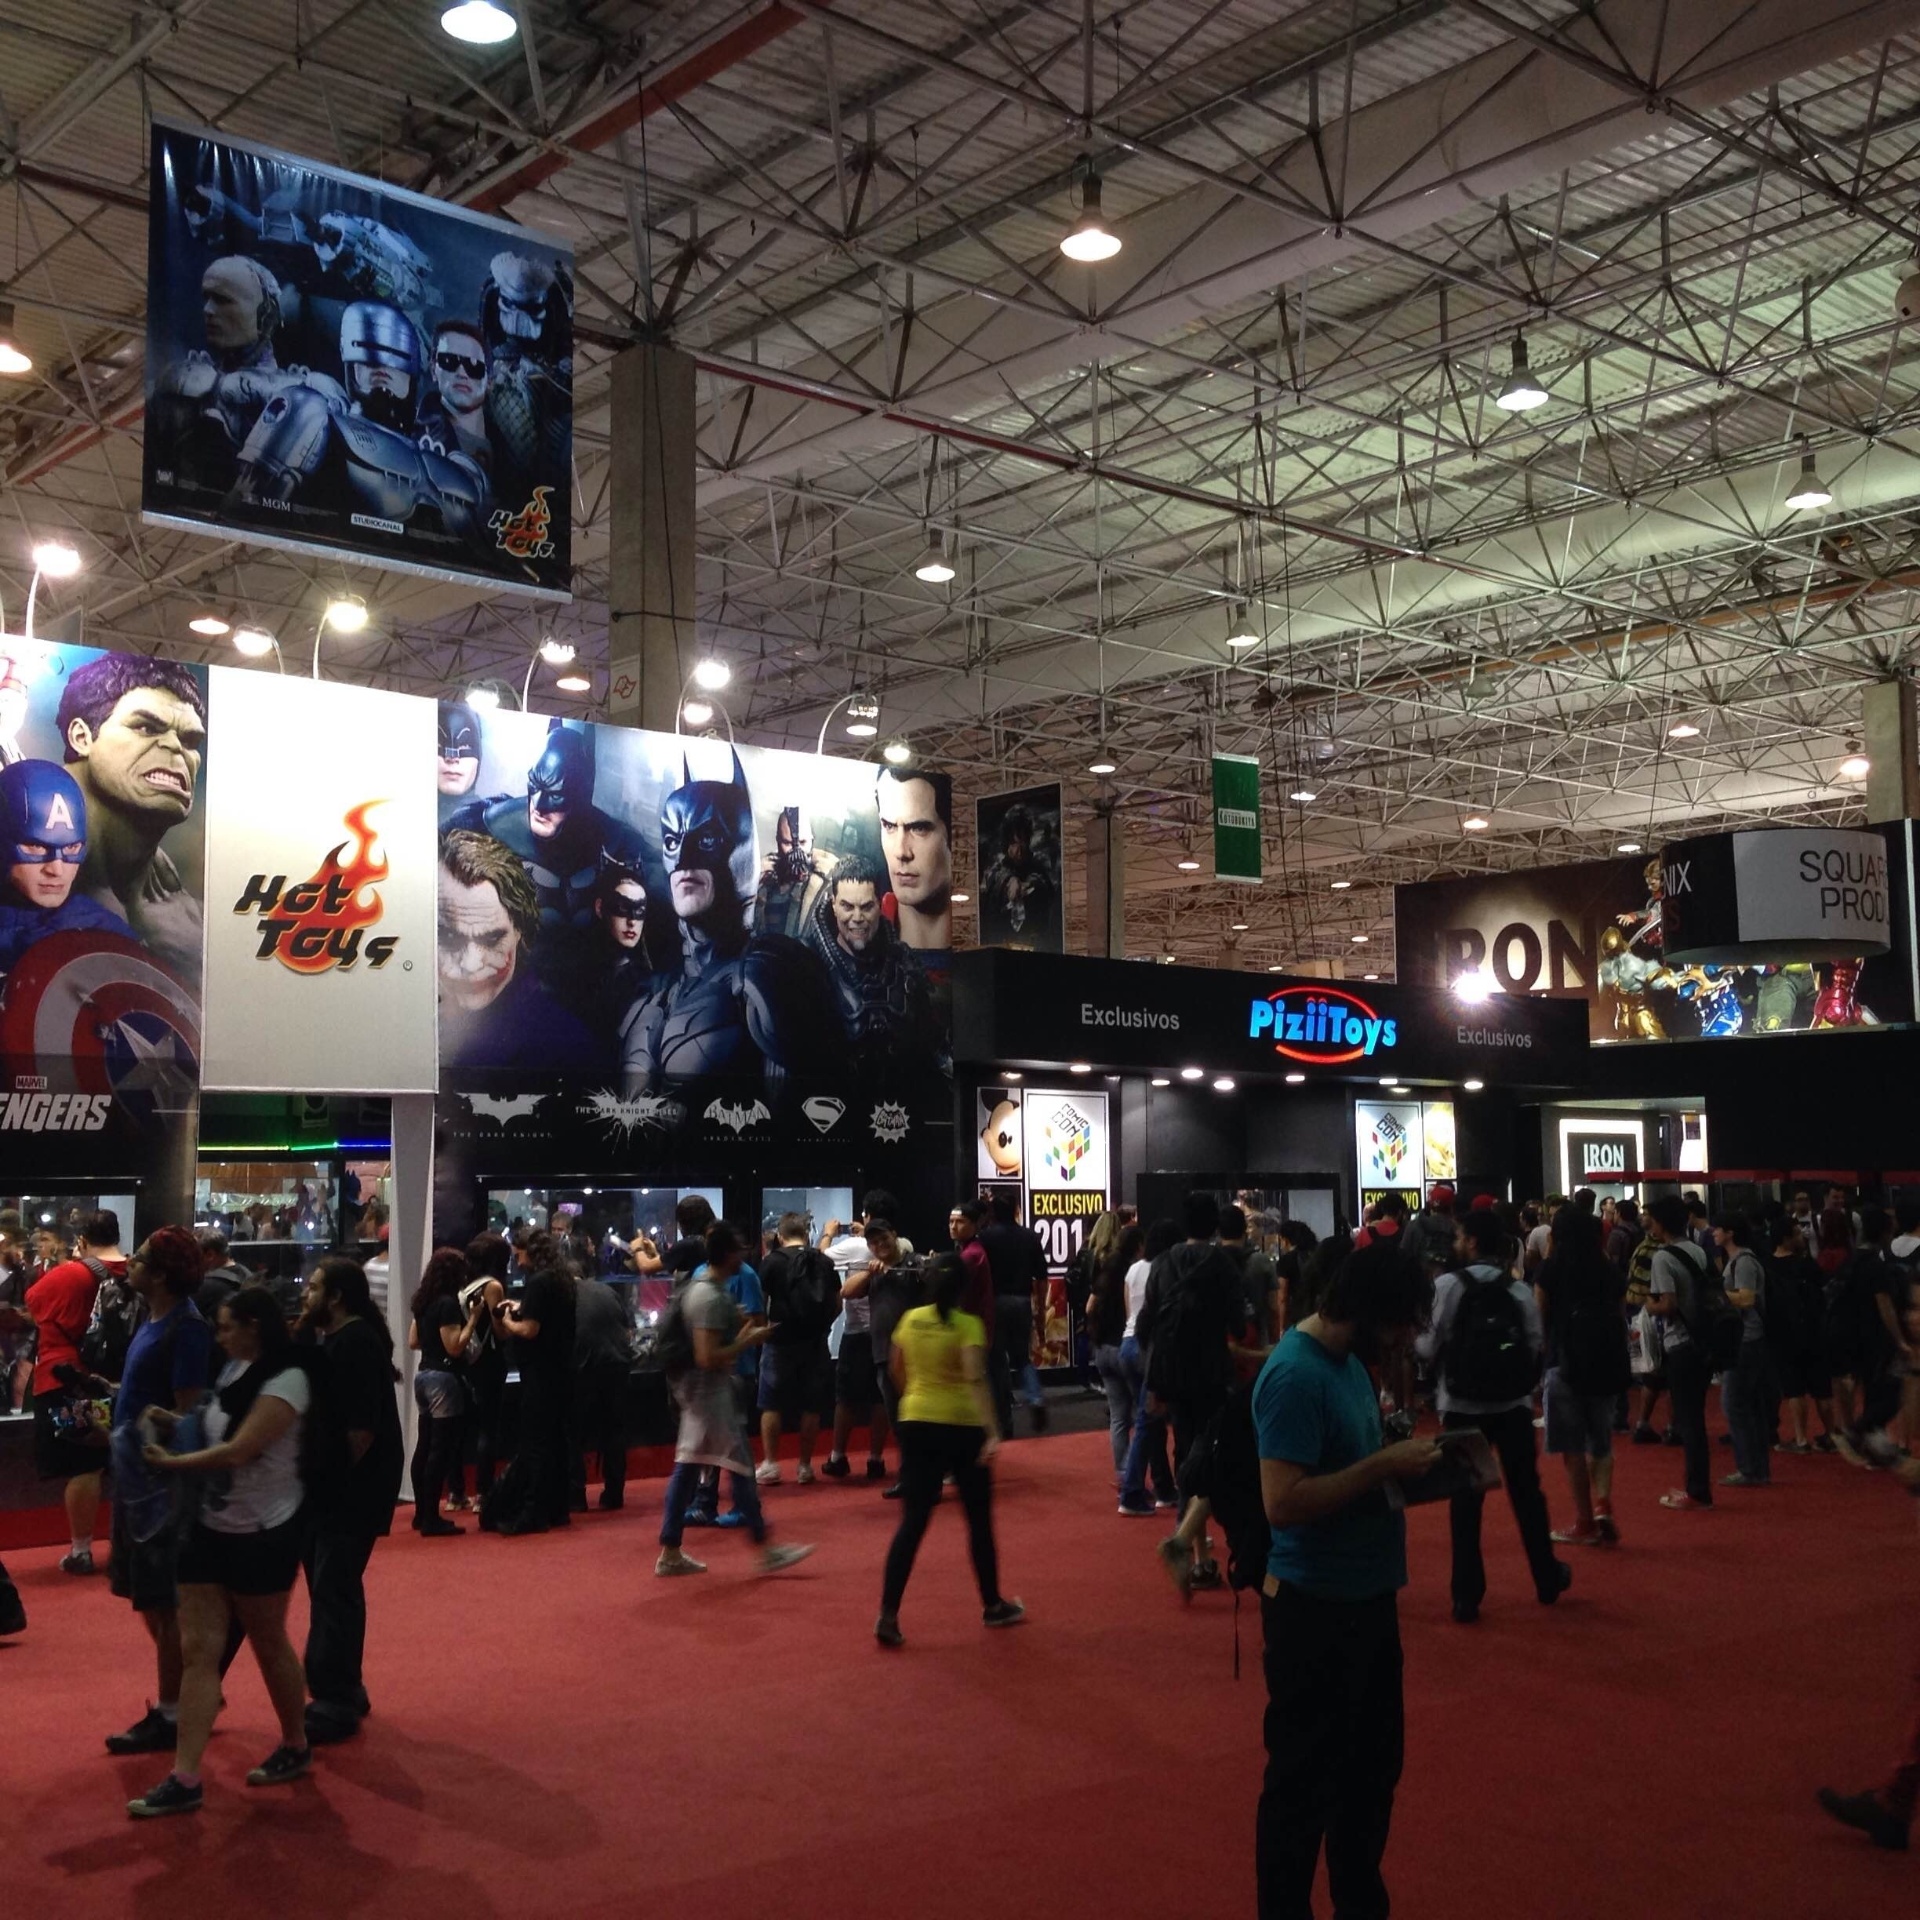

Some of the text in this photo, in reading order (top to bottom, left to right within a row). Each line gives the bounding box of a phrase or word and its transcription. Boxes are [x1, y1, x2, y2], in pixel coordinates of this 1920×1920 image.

[262, 496, 291, 512] MGM
[353, 515, 402, 532] STUDIOCANAL
[496, 530, 555, 558] Toys
[1800, 850, 1888, 889] SQUAR
[233, 874, 352, 915] Hot
[1820, 887, 1889, 925] PROD
[255, 919, 399, 969] Toys
[1081, 1003, 1180, 1030] Exclusivos
[1250, 999, 1396, 1056] PiziiToys
[1457, 1025, 1532, 1049] Exclusivos
[16, 1076, 47, 1089] MARVEL
[1051, 1111, 1081, 1137] CON
[1061, 1103, 1089, 1129] COMIC
[1384, 1112, 1406, 1135] COMIC
[1376, 1119, 1400, 1143] CON
[1583, 1143, 1624, 1168] IRON
[1033, 1193, 1104, 1216] EXCLUSIVO
